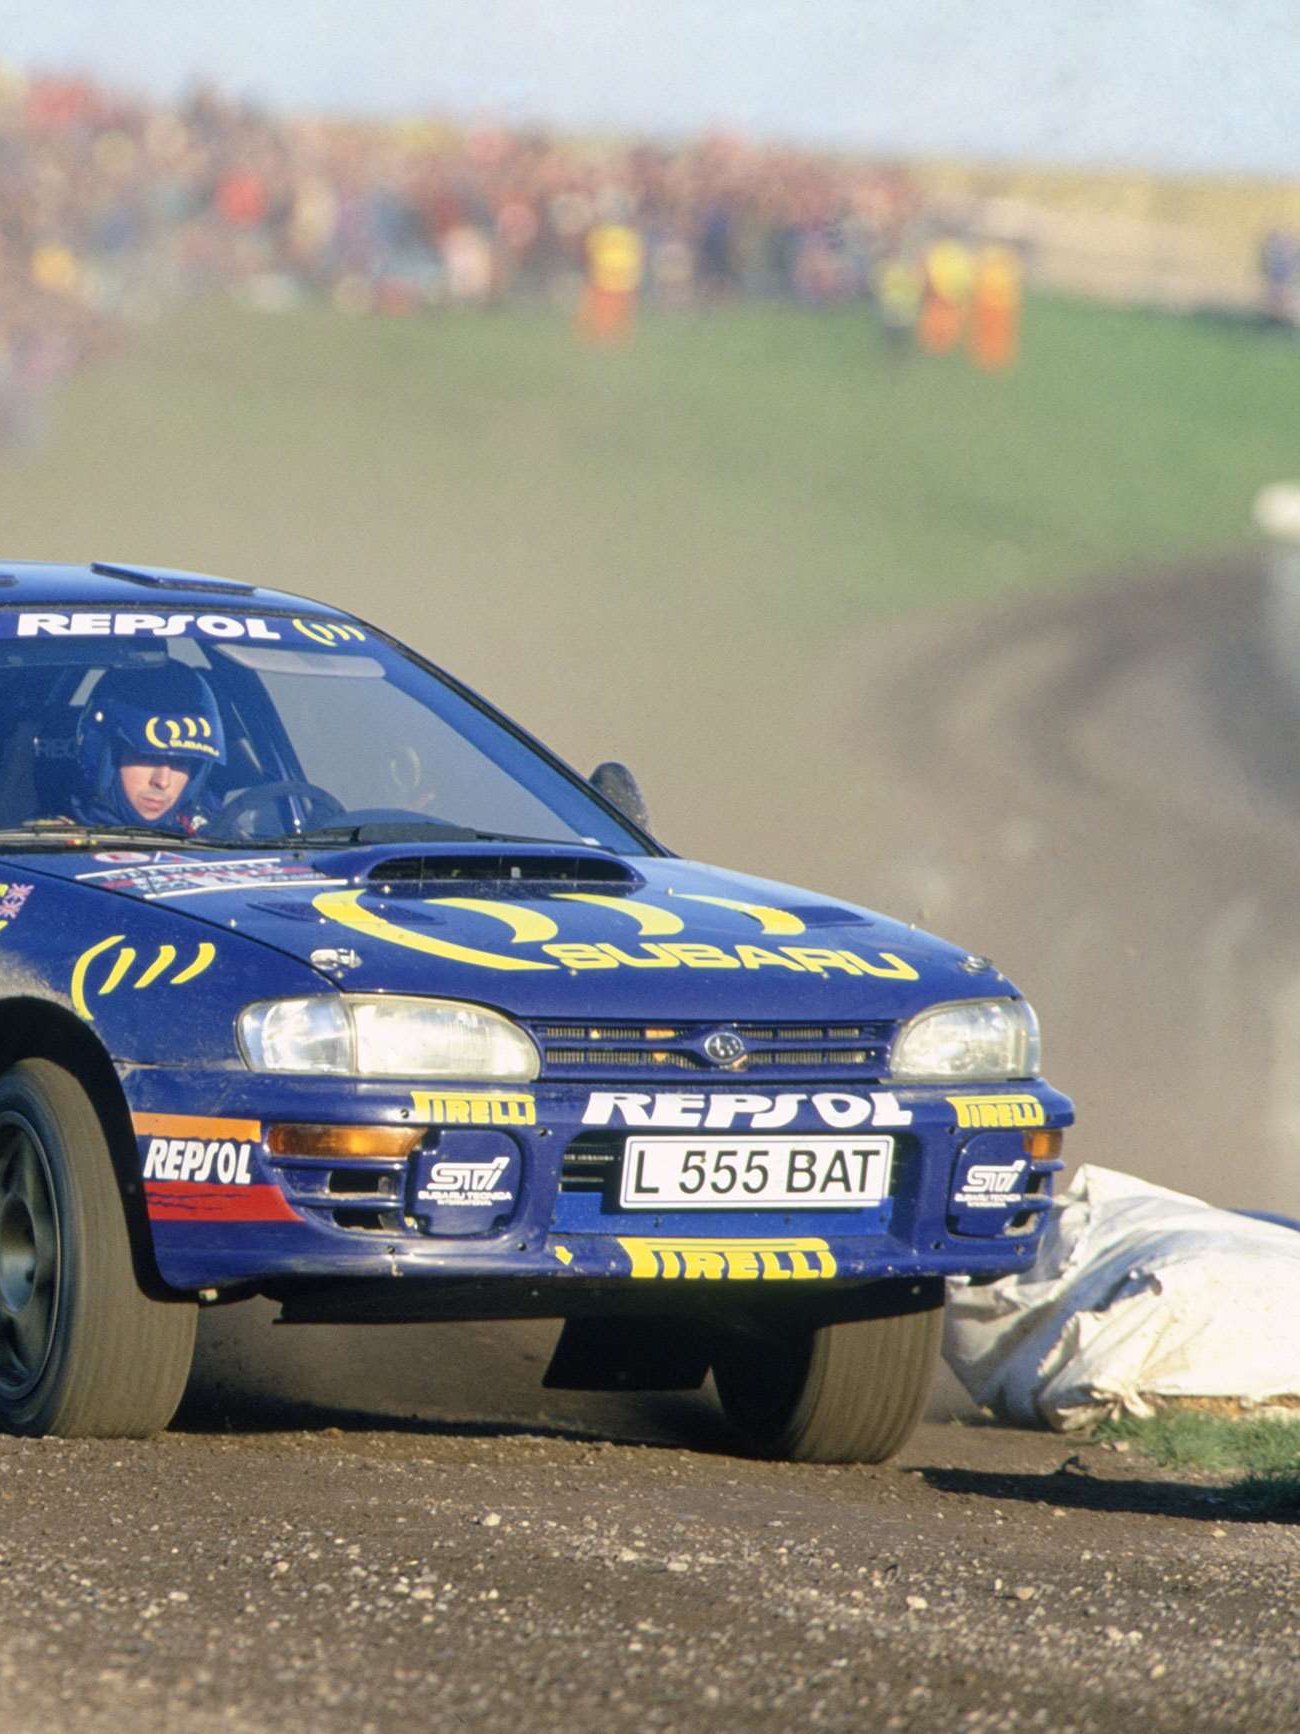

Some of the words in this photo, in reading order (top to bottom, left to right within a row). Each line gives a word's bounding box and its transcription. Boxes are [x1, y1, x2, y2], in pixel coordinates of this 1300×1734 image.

[17, 613, 281, 640] REPSOL
[542, 943, 920, 980] SUBARU
[410, 1091, 536, 1125] PIRELLI
[581, 1092, 913, 1128] REPSOL
[945, 1094, 1044, 1128] PIRELLI
[143, 1138, 251, 1184] REPSOL
[634, 1150, 660, 1194] L
[678, 1150, 770, 1194] 555
[785, 1150, 881, 1194] BAT
[617, 1237, 837, 1279] PIRELLI
